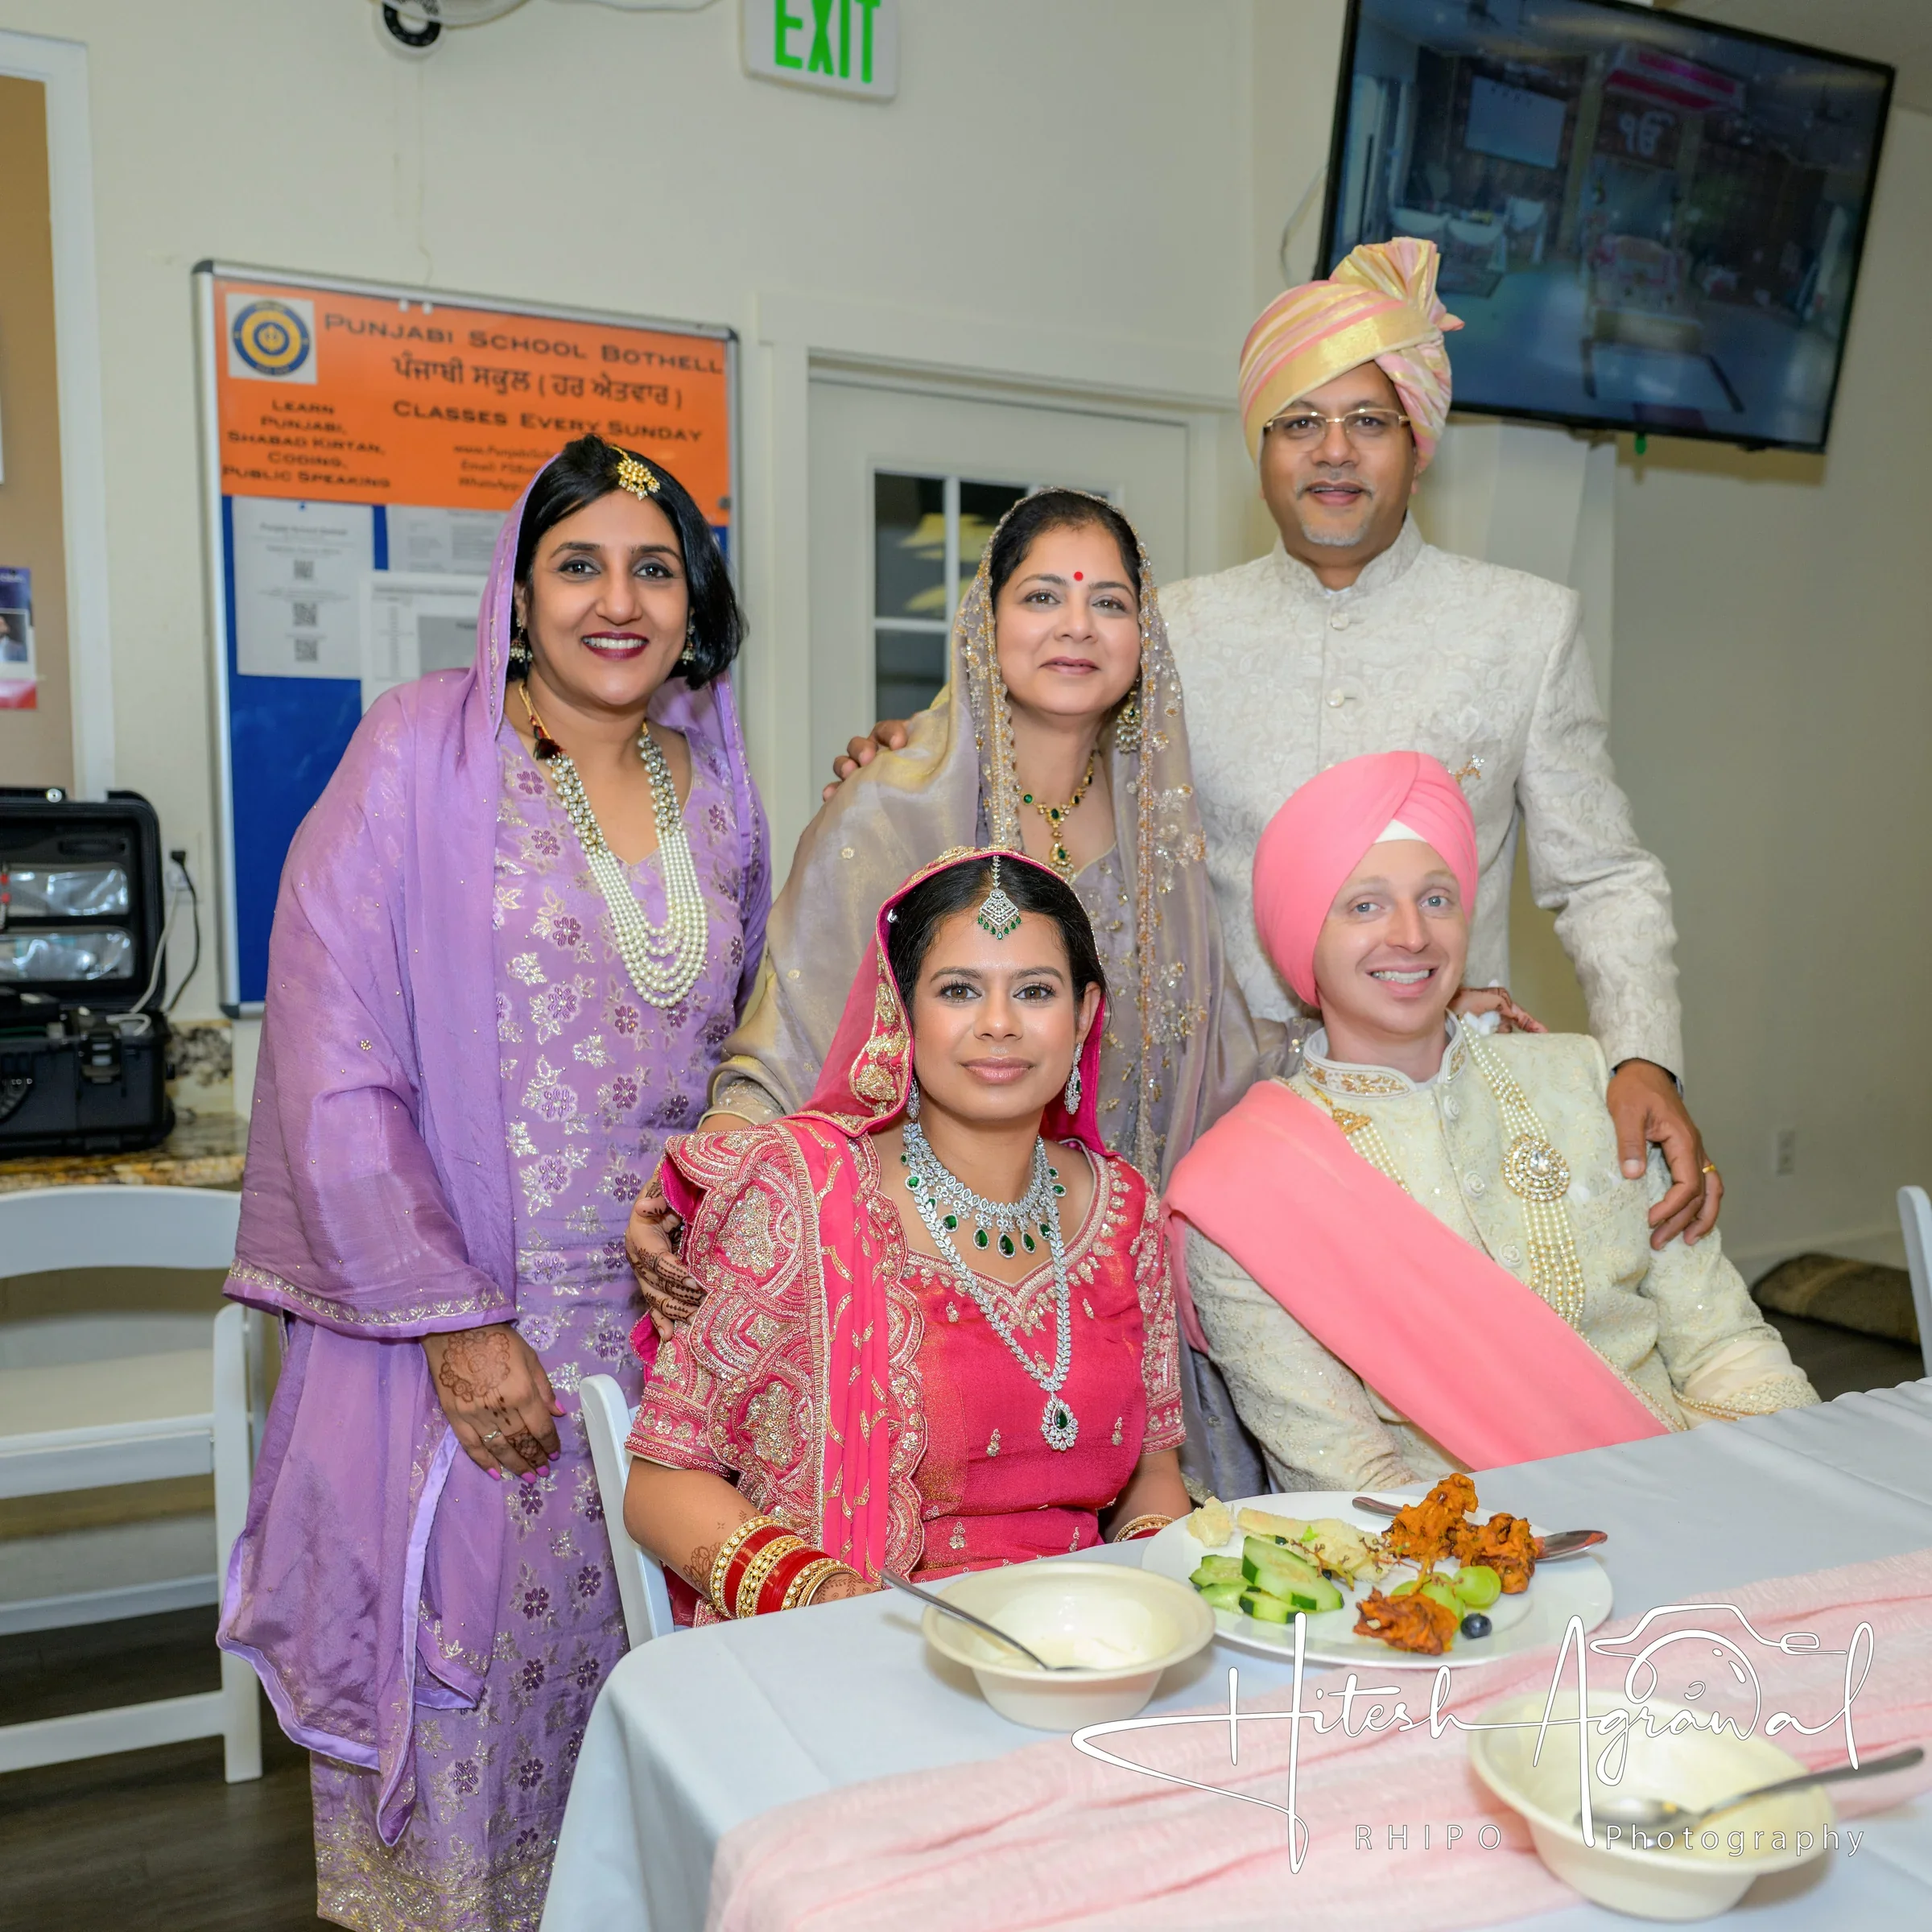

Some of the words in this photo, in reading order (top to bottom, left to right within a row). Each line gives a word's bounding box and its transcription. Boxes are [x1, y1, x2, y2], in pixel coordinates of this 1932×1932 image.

[774, 0, 881, 84] EXIT
[324, 312, 454, 344] PUNJABI
[469, 330, 588, 359] SCHOOL
[601, 345, 723, 374] BOTHELL
[393, 400, 507, 426] CLASSES
[608, 419, 702, 441] SUNDAY
